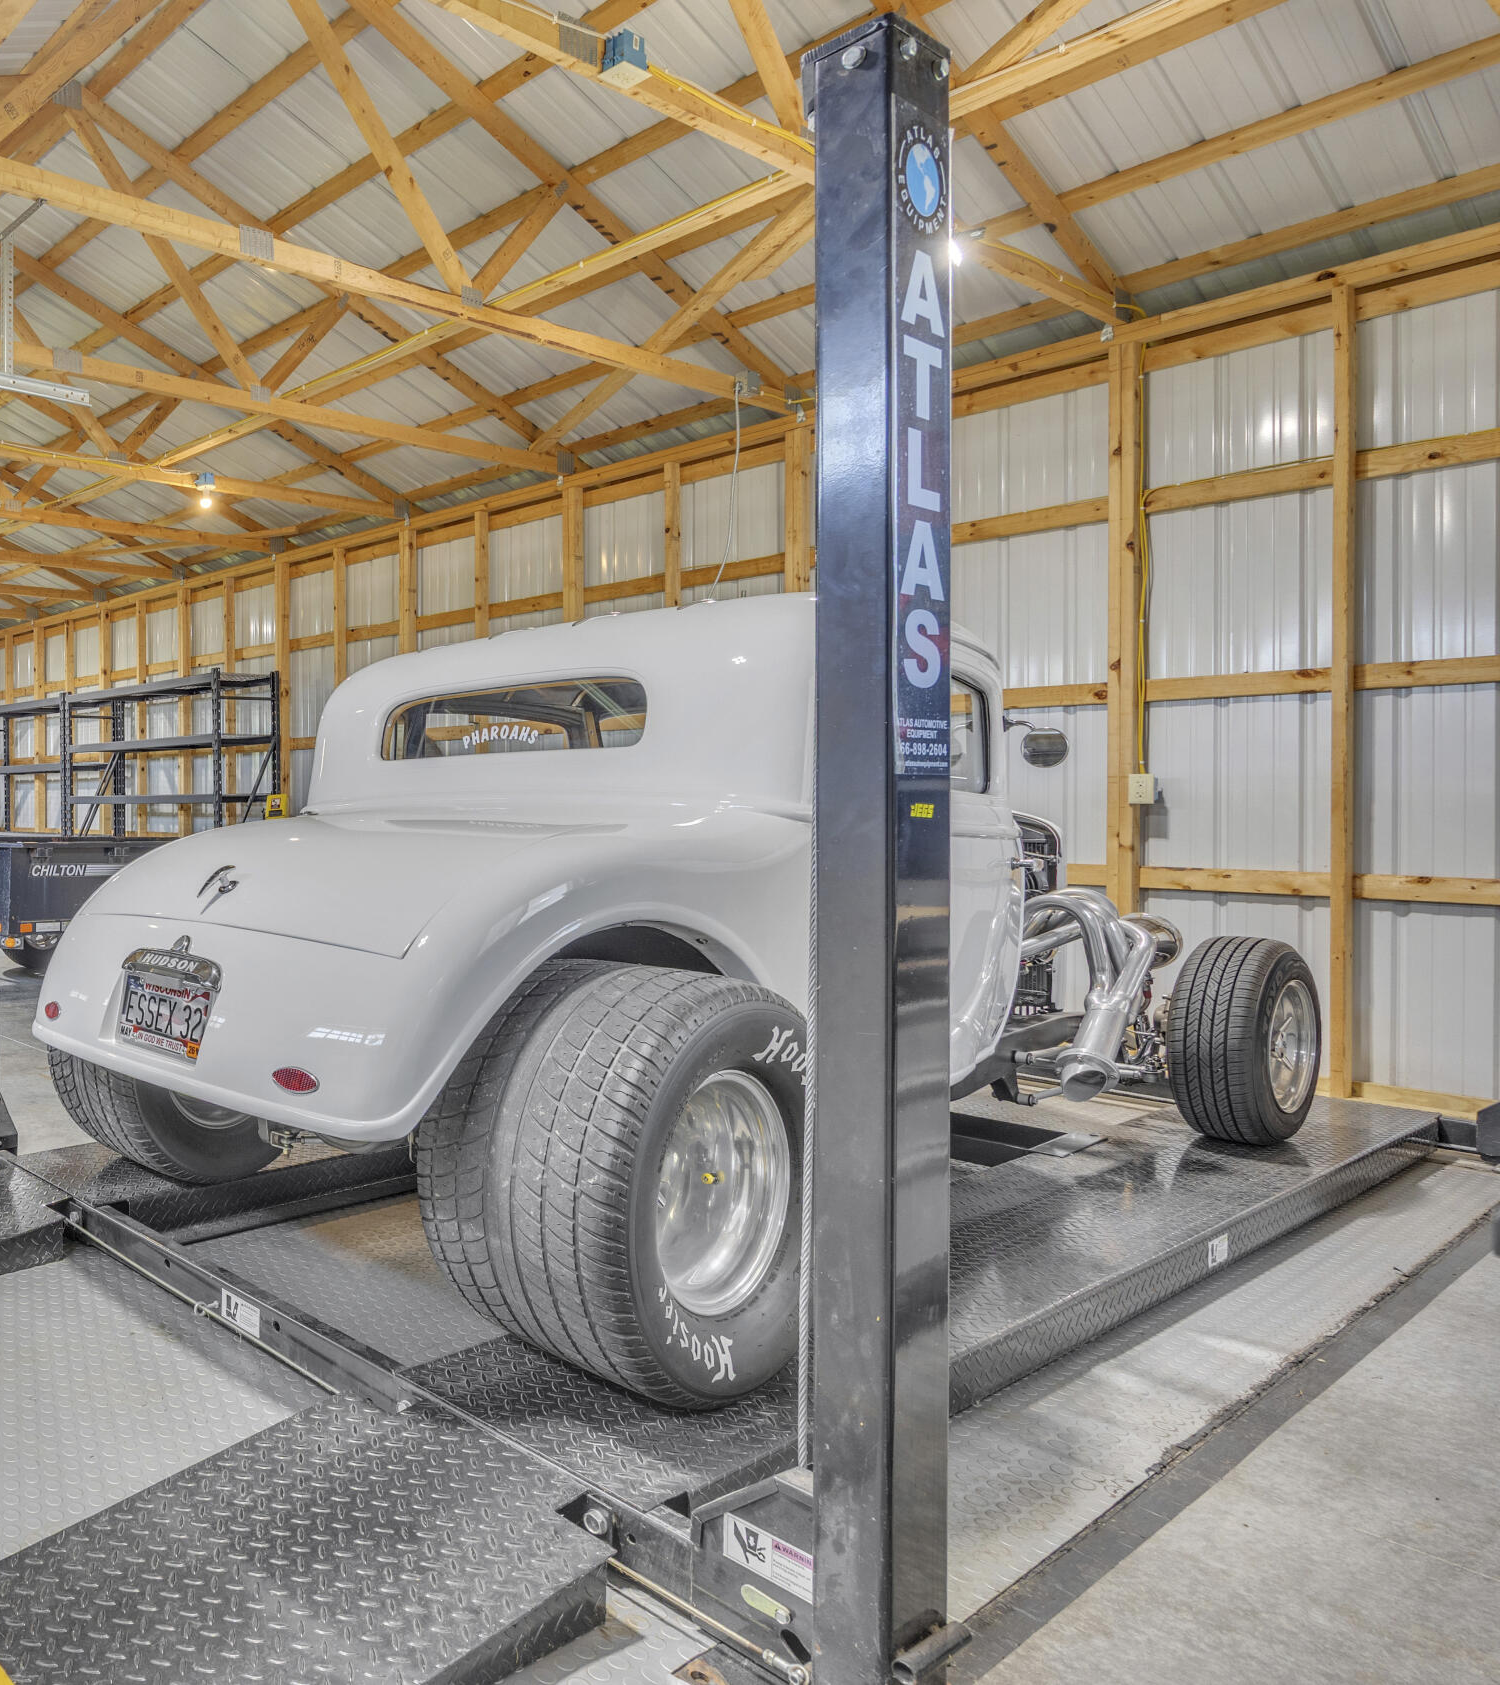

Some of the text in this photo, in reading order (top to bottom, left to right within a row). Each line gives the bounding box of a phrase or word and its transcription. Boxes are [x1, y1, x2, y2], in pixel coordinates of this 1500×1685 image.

[906, 126, 940, 159] ATLAS
[898, 174, 947, 234] EQUIPMENT
[900, 249, 946, 689] ATLAS
[906, 729, 938, 739] EQUIPMENT
[914, 718, 948, 730] AUTOMOTIVE
[462, 724, 539, 749] PHAROAHS
[899, 742, 948, 756] 66-898-2604
[31, 864, 85, 877] CHILTON
[141, 952, 199, 974] HUDSON
[125, 990, 203, 1043] ESSEX 32
[120, 1024, 133, 1038] MAY
[143, 1033, 156, 1045] GOD
[155, 1036, 165, 1048] WE
[165, 1039, 183, 1053] TRUST
[782, 1546, 812, 1566] WARNIN
